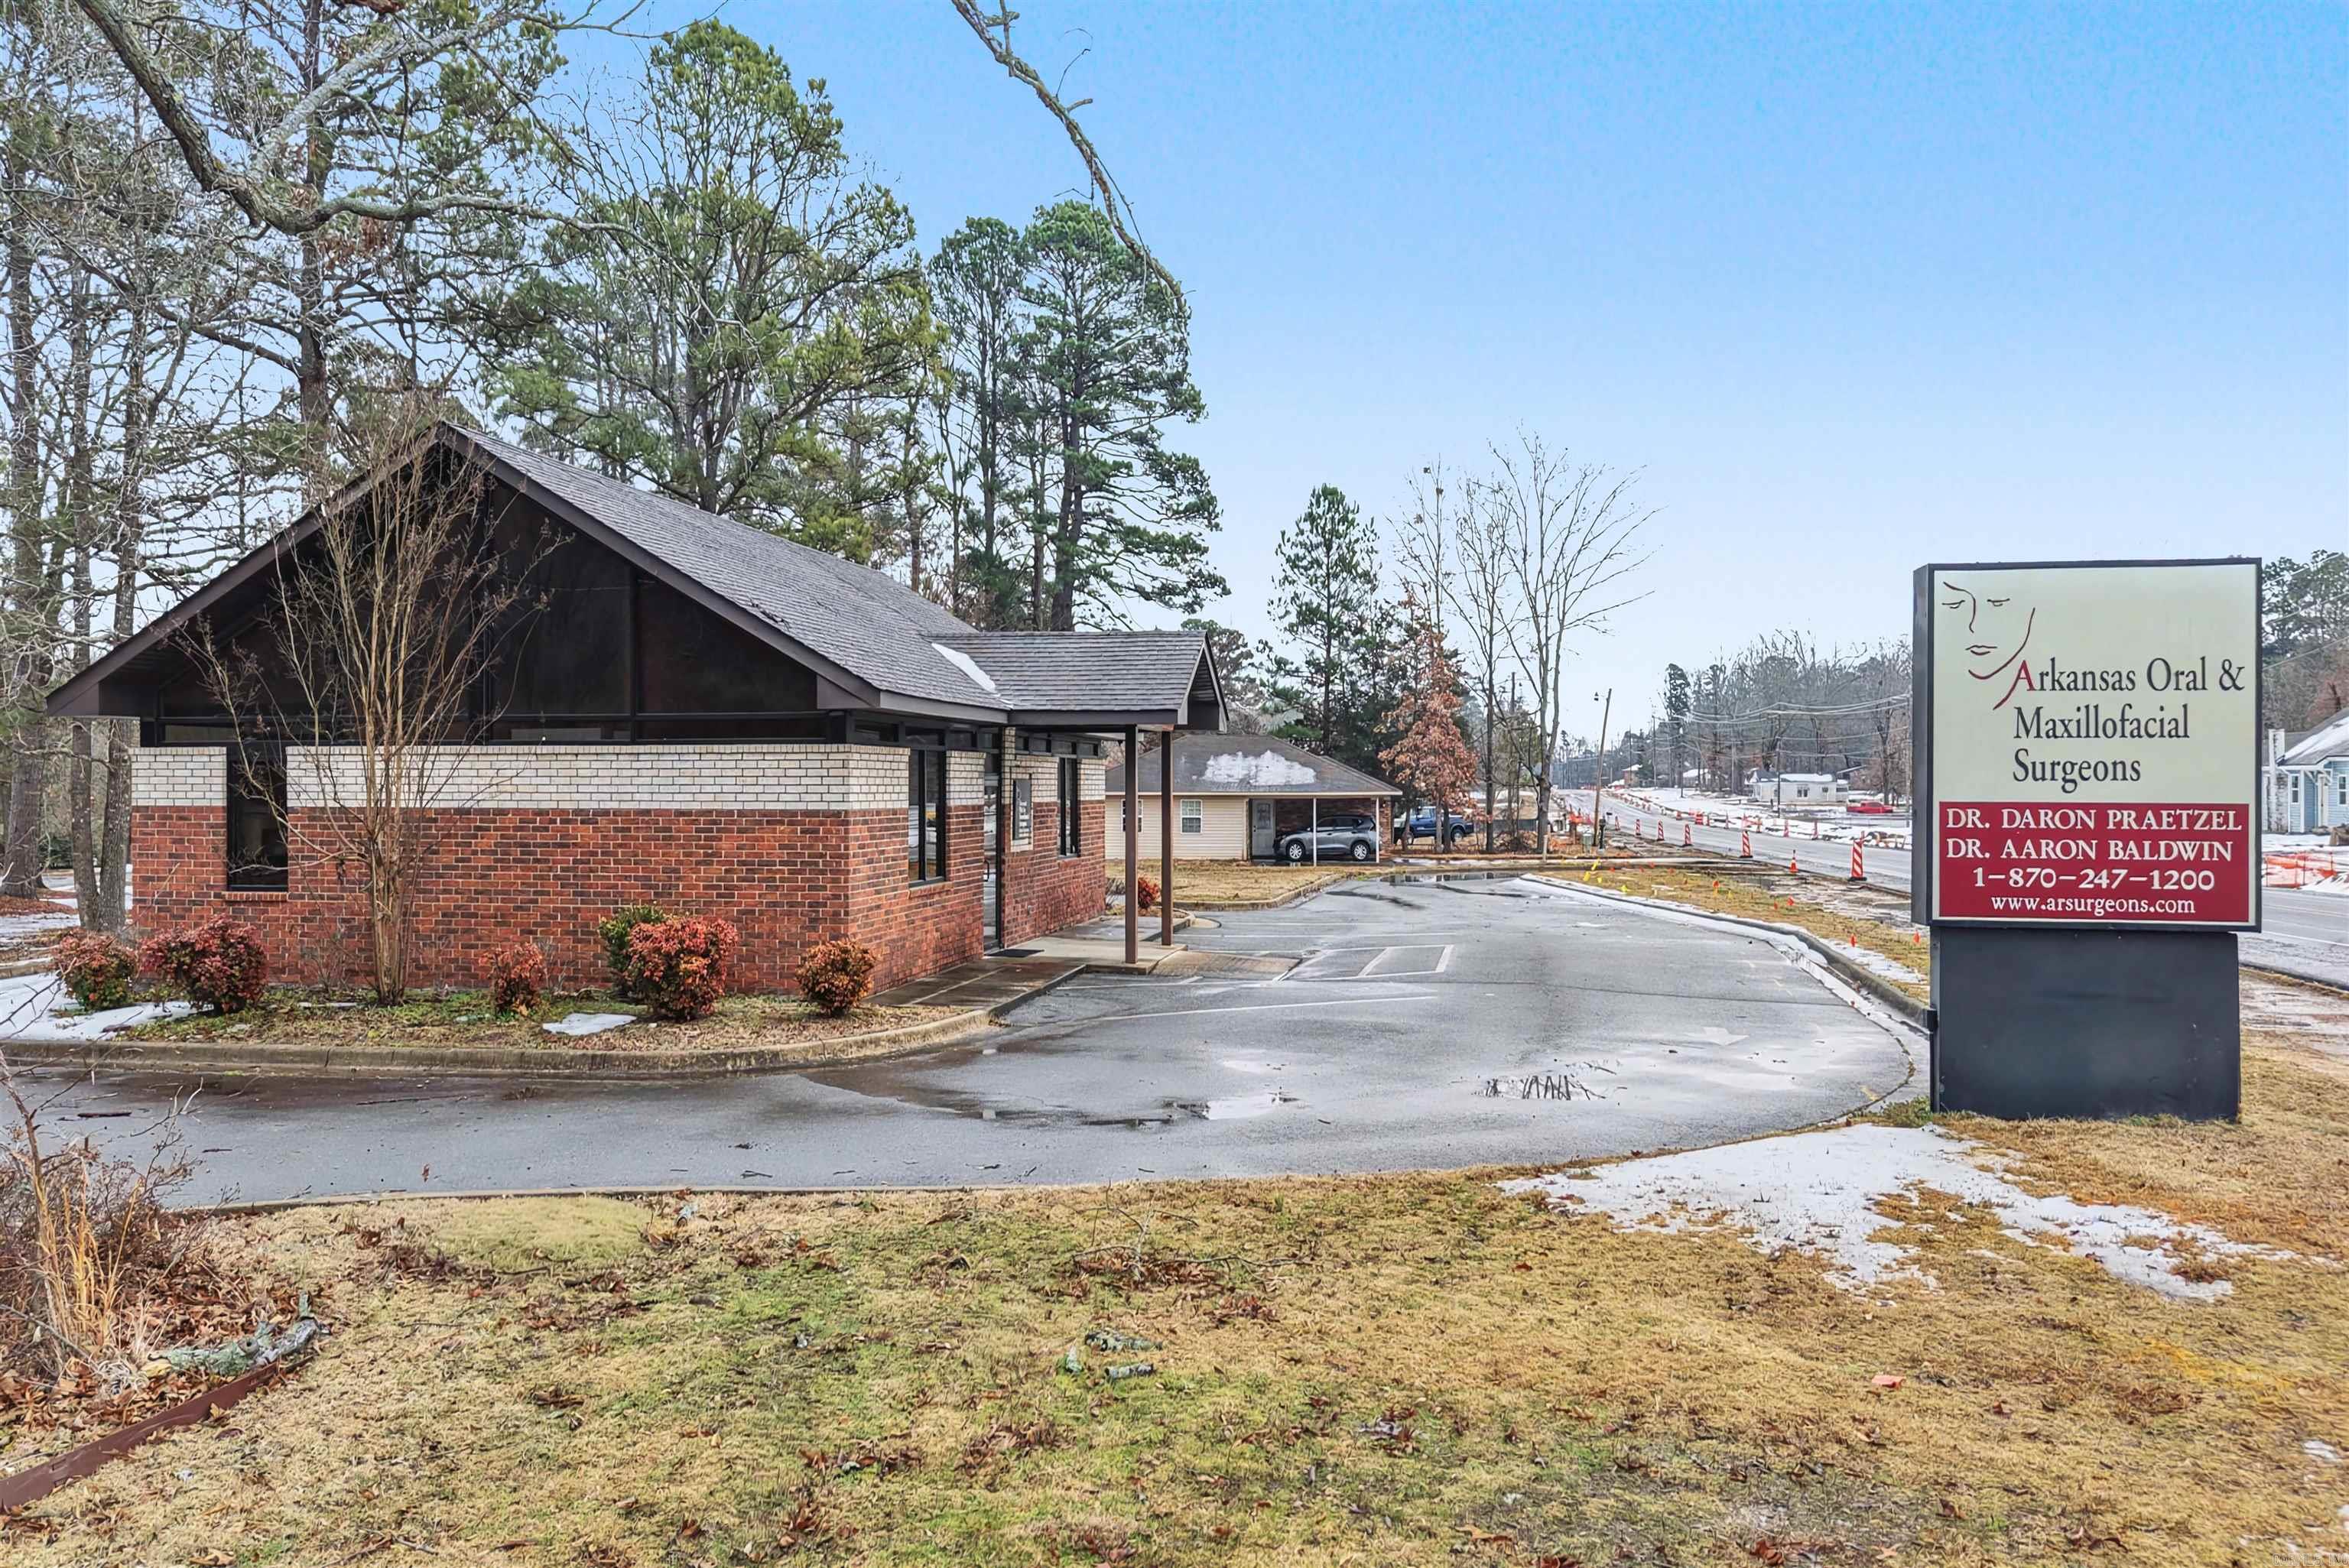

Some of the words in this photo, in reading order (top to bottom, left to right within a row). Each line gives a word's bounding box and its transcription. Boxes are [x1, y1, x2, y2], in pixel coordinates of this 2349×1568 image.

[2014, 656, 2136, 691] Arkansas
[2146, 656, 2208, 691] Oral
[2218, 658, 2245, 690] &
[2013, 703, 2190, 739] Maxillofacial
[2013, 748, 2142, 794] Surgeons
[1946, 808, 1990, 829] DR.
[2001, 808, 2096, 830] DARON
[2107, 809, 2242, 831] PRAETZEL
[1946, 838, 1990, 859] DR.
[2000, 839, 2097, 861] AARON
[2108, 840, 2233, 862] BALDWIN
[1972, 866, 2215, 891] 1-870-247-1200
[1990, 895, 2196, 917] www.arsurgeons.com
